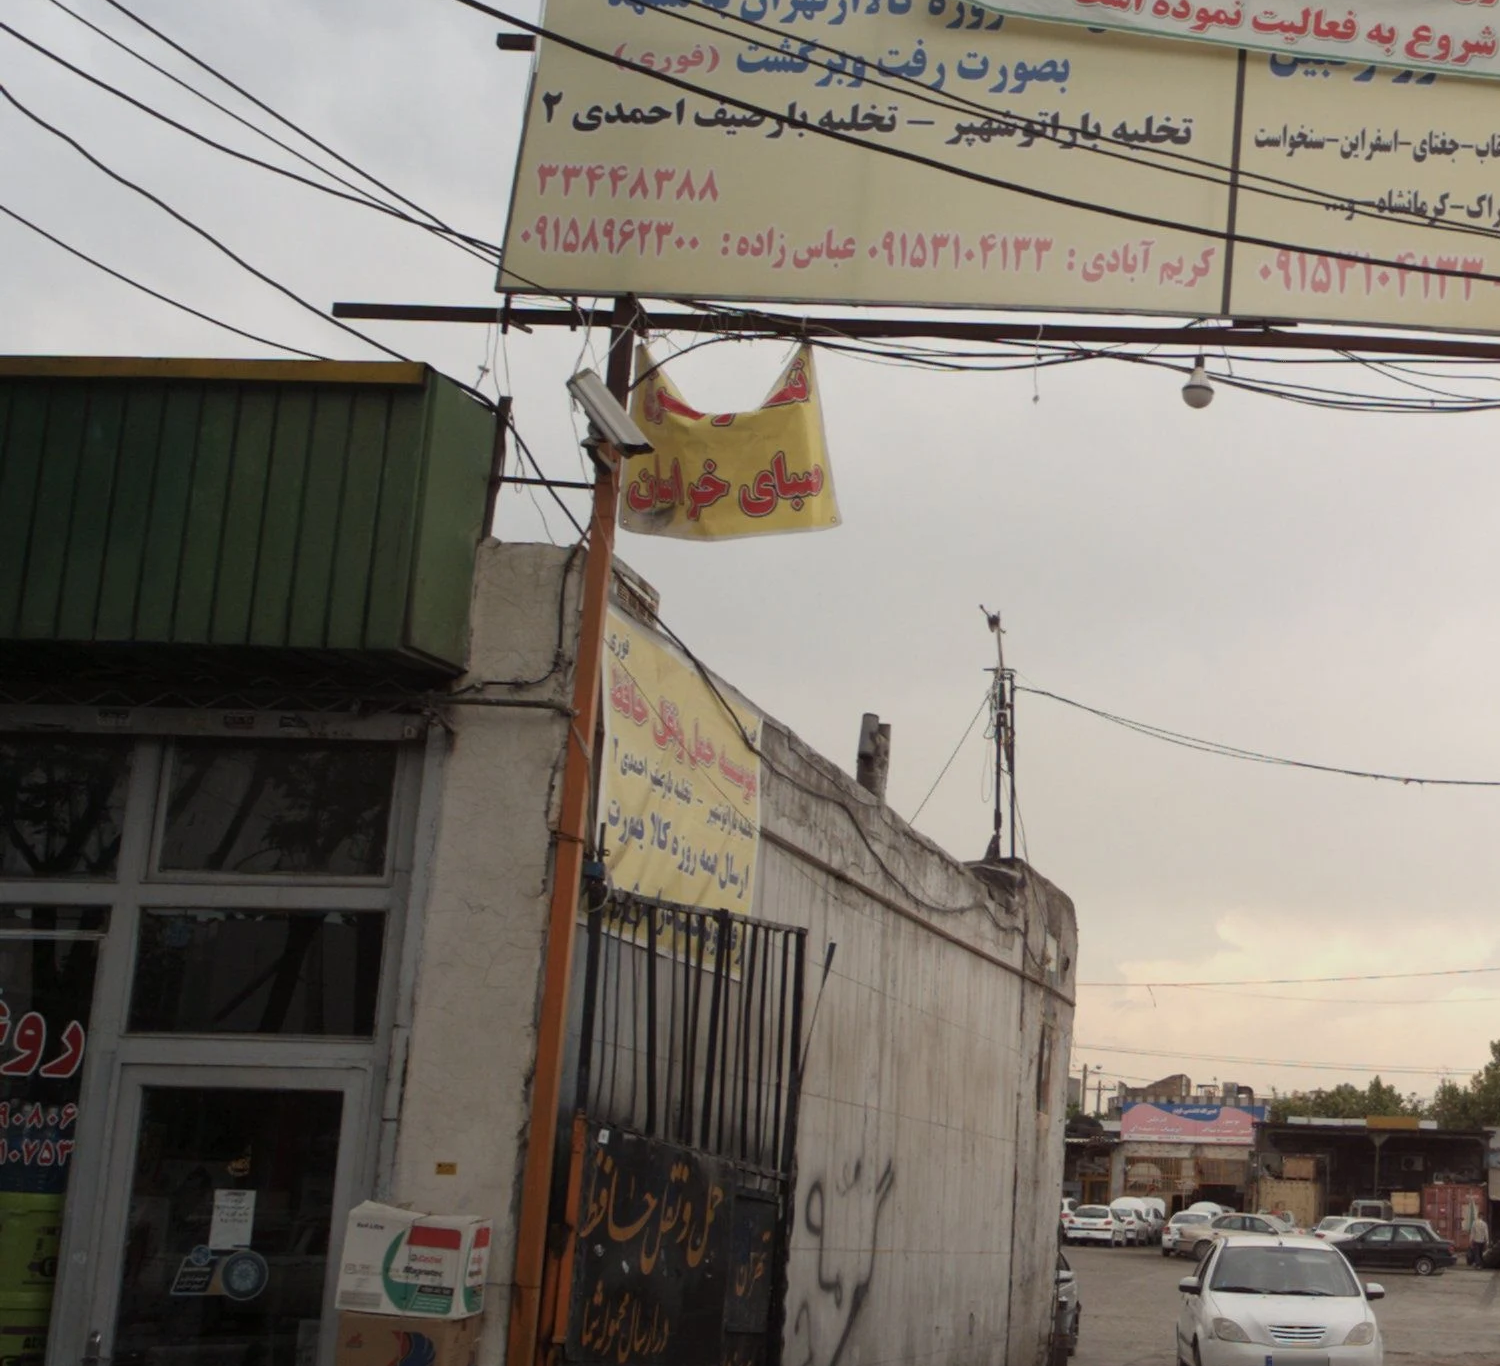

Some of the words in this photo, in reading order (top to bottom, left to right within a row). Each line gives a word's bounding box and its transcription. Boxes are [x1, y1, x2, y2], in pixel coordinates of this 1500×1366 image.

[1250, 6, 1358, 43] فعالیت
[1366, 20, 1397, 58] به
[1404, 24, 1499, 65] شروع
[877, 38, 948, 93] رفت
[956, 53, 1071, 95] بصورت
[542, 91, 563, 123] ۲
[572, 98, 686, 132] احمدی
[817, 102, 897, 134] تخلیه
[1111, 115, 1194, 151] تخلیه
[1340, 127, 1399, 161] اسفراین
[536, 163, 719, 202] ۳۳۴۴۸۳۸۸
[1376, 188, 1451, 225] کرمانشاه
[792, 230, 857, 270] عباس
[868, 230, 1054, 273] ۰۹۱۵۳۱۰۴۱۳۳
[1158, 246, 1216, 287] کریم
